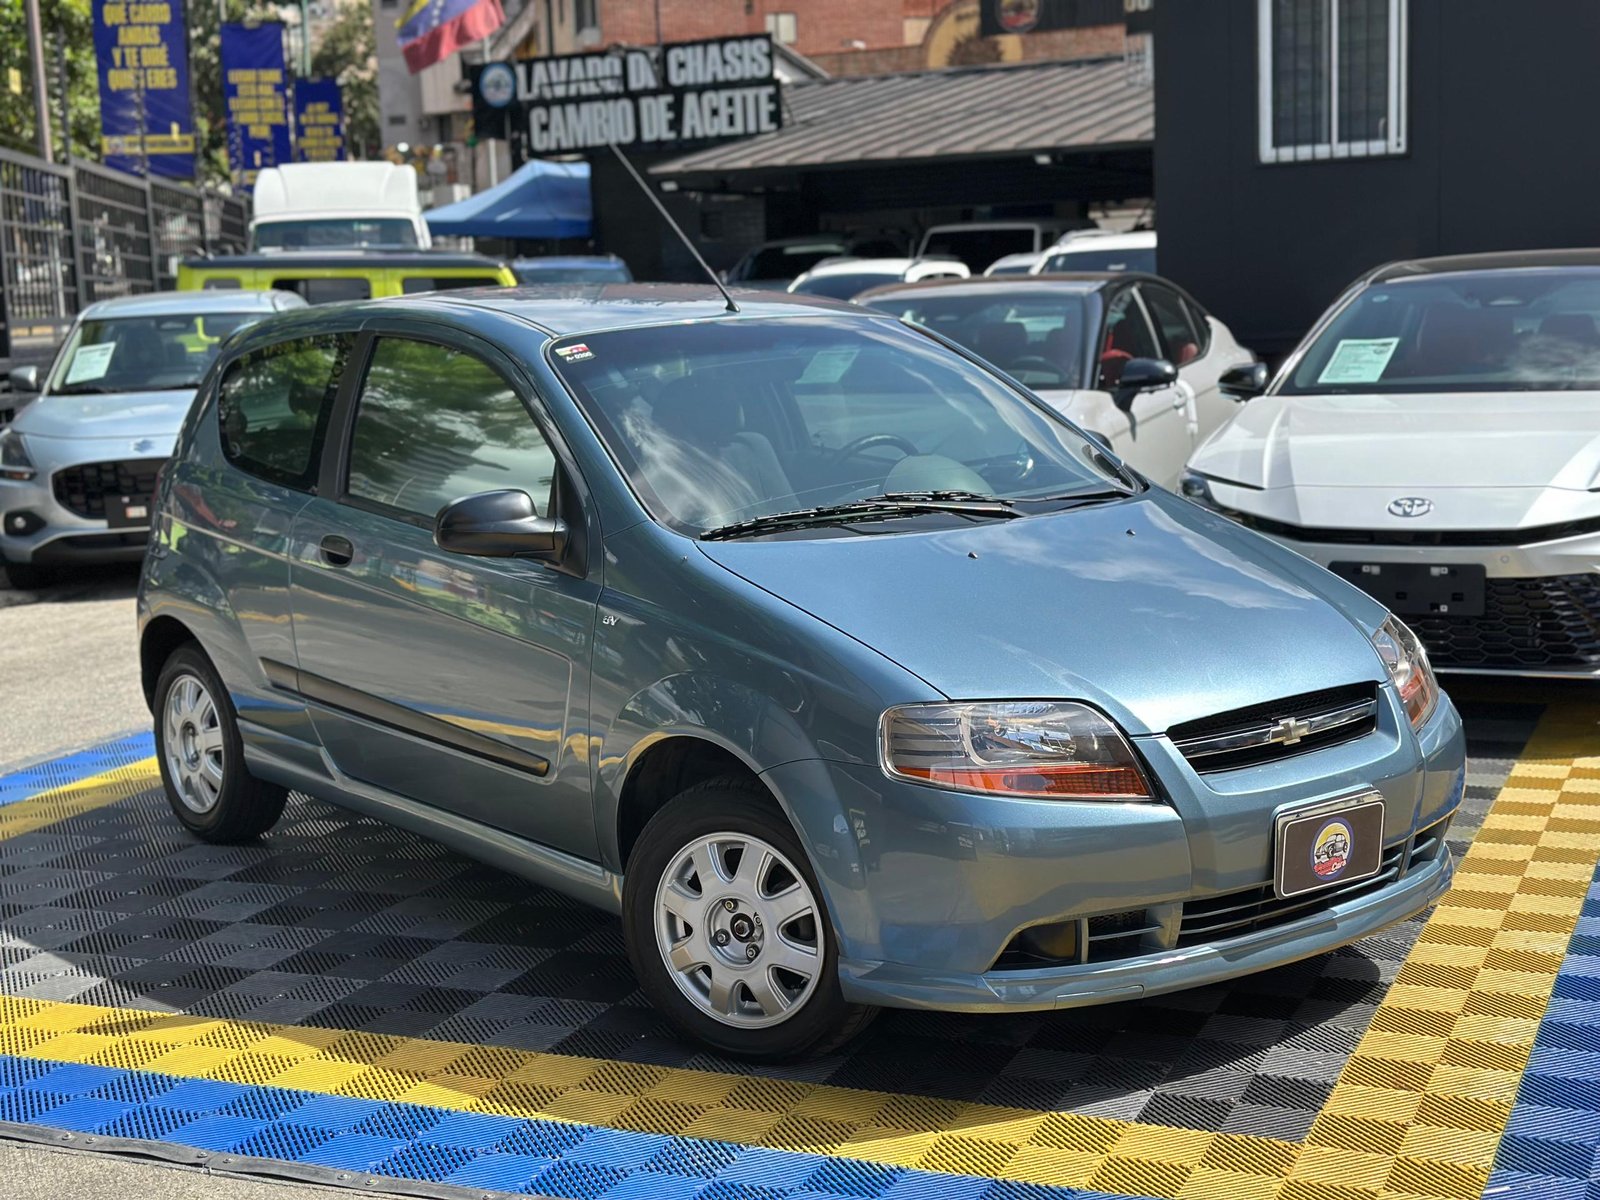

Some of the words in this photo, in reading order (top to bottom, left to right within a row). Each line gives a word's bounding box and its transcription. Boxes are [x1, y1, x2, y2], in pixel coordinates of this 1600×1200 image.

[667, 39, 770, 87] CHASIS
[529, 98, 637, 152] CAMBIO
[639, 95, 676, 143] DE
[682, 86, 778, 140] ACEITE
